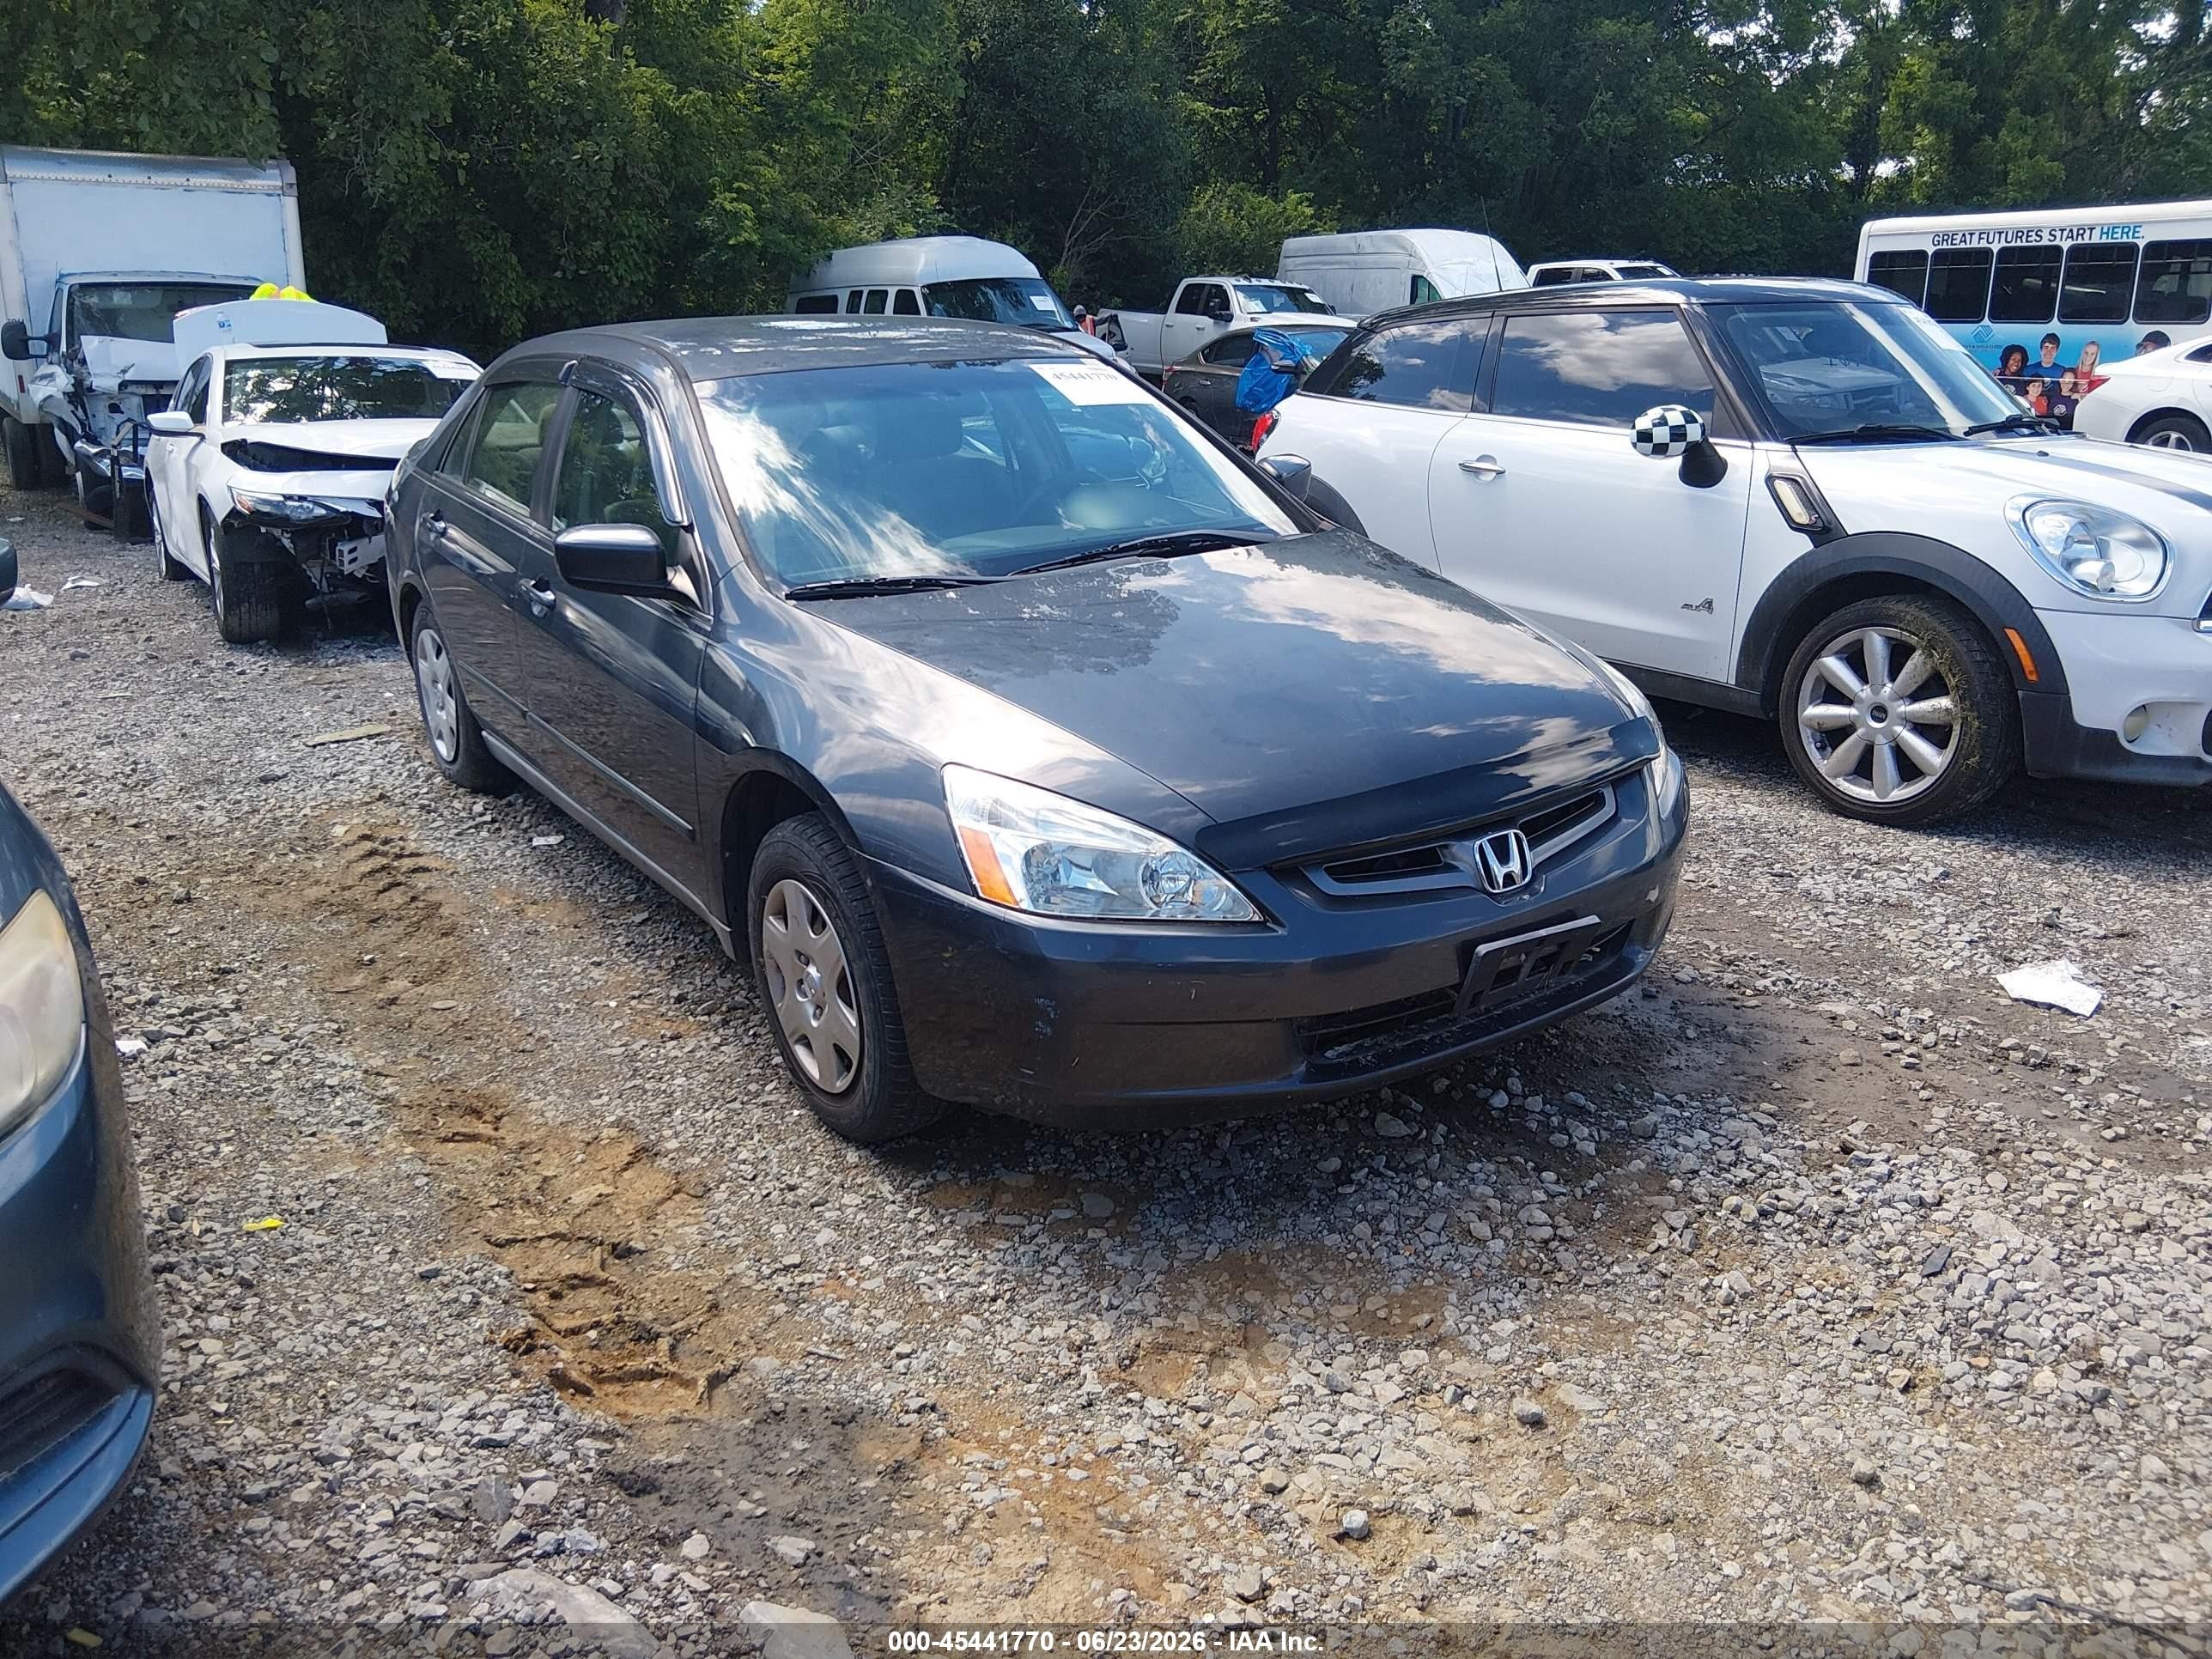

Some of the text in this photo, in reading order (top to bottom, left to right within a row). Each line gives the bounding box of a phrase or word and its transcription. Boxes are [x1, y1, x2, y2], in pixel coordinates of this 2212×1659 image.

[1931, 225, 2145, 246] GREAT FUTURES START HERE.
